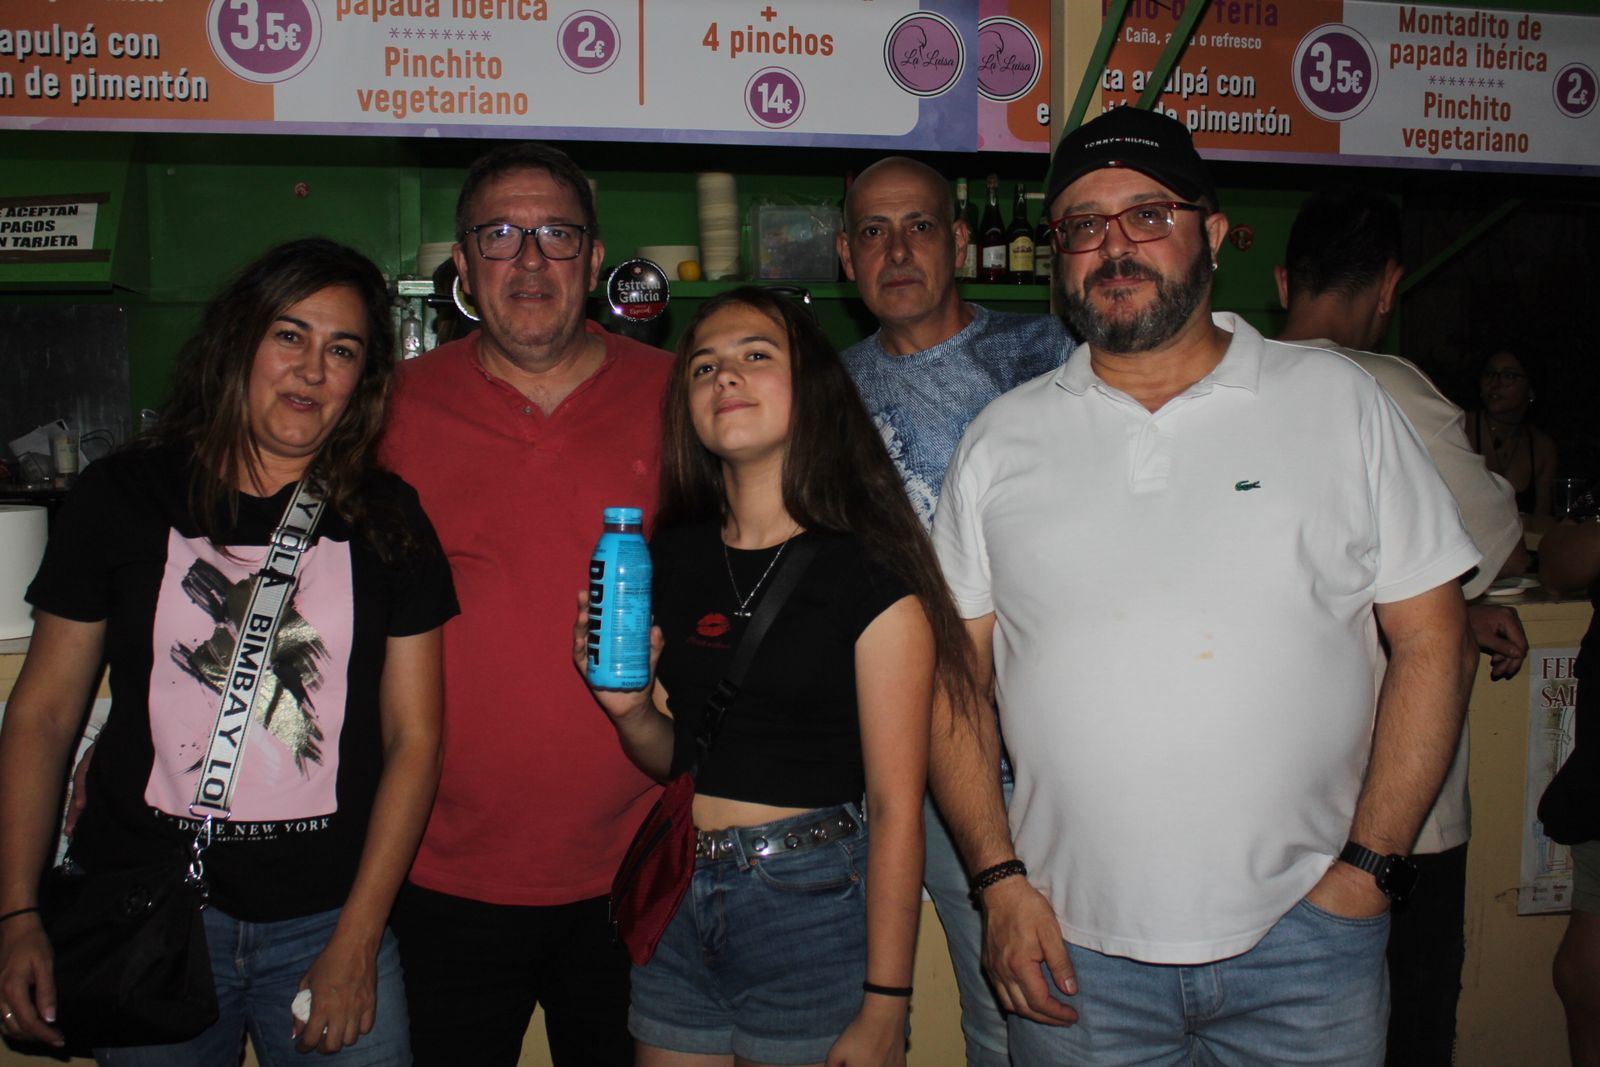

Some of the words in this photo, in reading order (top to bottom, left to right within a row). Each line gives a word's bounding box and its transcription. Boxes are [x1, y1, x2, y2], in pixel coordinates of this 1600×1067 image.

[1126, 26, 1160, 46] Caña,
[1199, 35, 1207, 47] o
[1211, 33, 1262, 50] refresco
[1399, 6, 1509, 39] Montadito
[1517, 14, 1542, 41] de
[108, 32, 159, 57] con
[577, 21, 605, 59] 2€
[703, 23, 719, 51] 4
[731, 25, 833, 58] pinchos
[385, 47, 502, 79] Pinchito
[901, 49, 919, 70] La
[922, 49, 955, 70] Luisa
[978, 55, 996, 75] La
[1000, 55, 1031, 75] Luisa
[1309, 42, 1363, 94] 3,5€
[1390, 41, 1468, 70] papada
[1476, 43, 1548, 72] ibérica
[25, 66, 59, 97] de
[71, 67, 207, 104] pimentón
[758, 82, 792, 114] 14€
[1132, 66, 1208, 99] alpá
[1216, 74, 1255, 97] con
[1567, 72, 1588, 105] 2€
[357, 86, 528, 118] vegetariano
[1424, 91, 1511, 122] Pinchito
[1187, 104, 1291, 135] pimentón
[1084, 137, 1115, 149] TOMMY
[1125, 136, 1160, 148] HILFIGER
[1402, 127, 1529, 154] vegetariano
[1, 220, 56, 233] PAGOS
[5, 205, 79, 218] ACEPTAN
[12, 235, 78, 248] TARJETA
[235, 824, 276, 836] NEW
[285, 818, 329, 833] YORK
